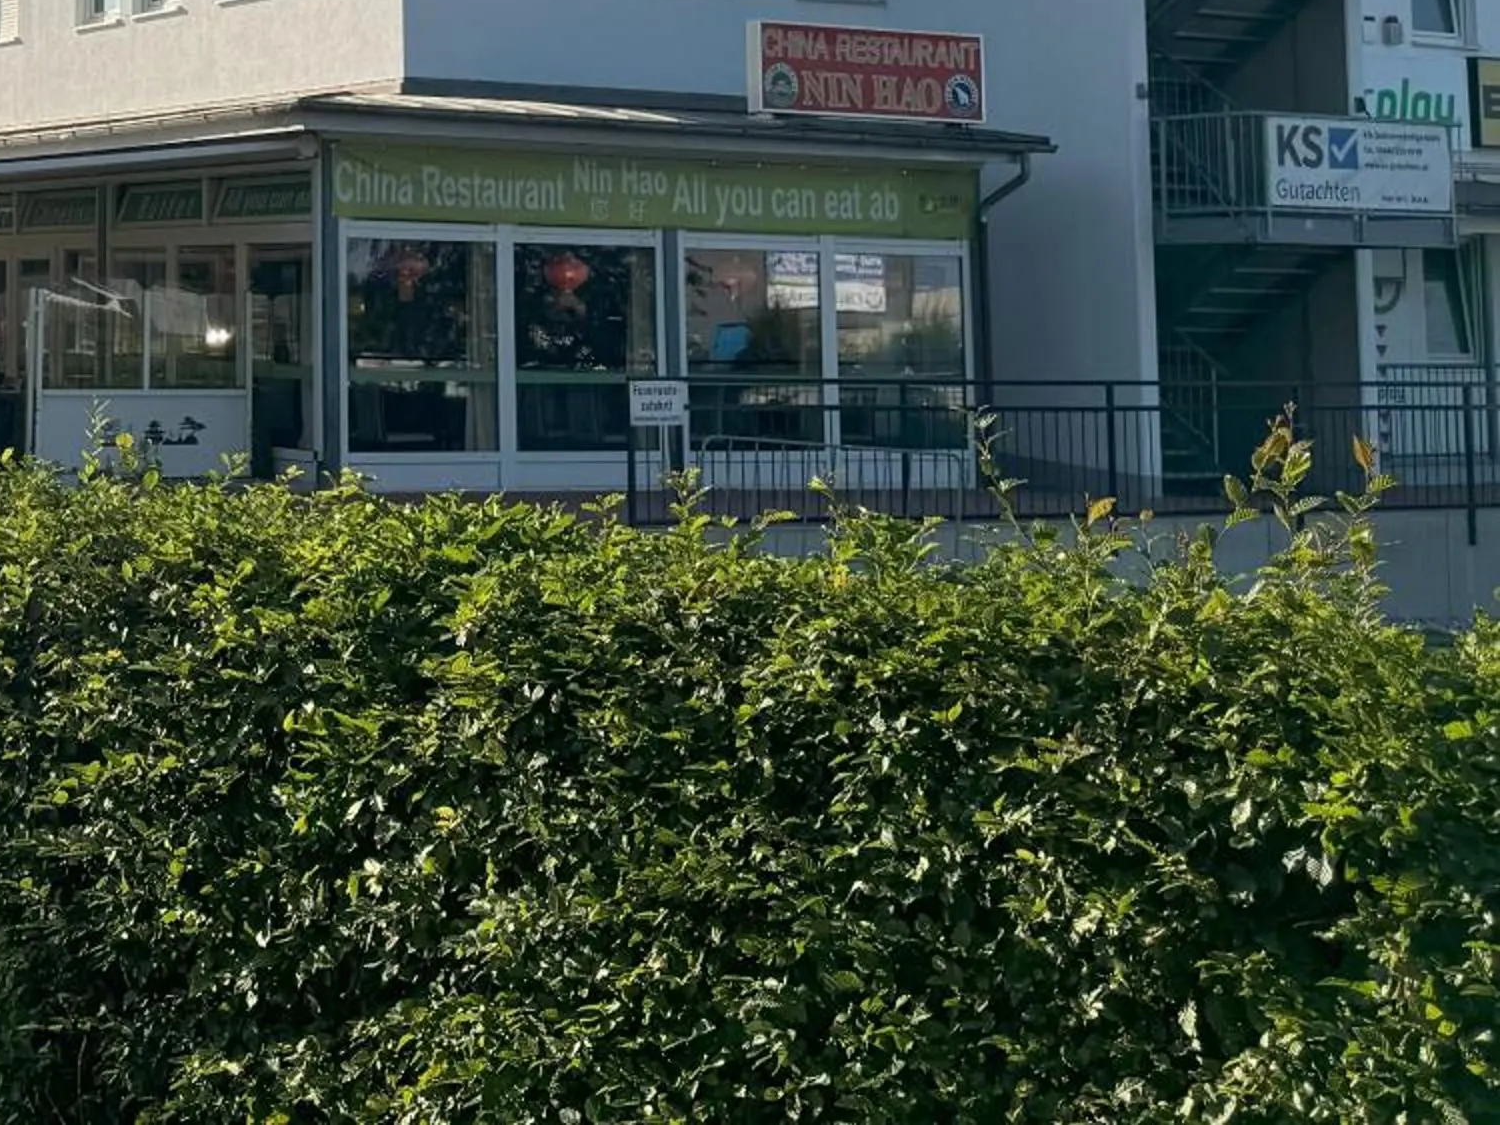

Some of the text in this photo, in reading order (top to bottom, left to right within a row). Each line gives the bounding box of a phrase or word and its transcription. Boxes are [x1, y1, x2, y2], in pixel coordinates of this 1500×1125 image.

[763, 28, 979, 71] CHINA RESTAURANT
[801, 70, 863, 109] NIN
[872, 74, 943, 114] HAO
[1275, 125, 1325, 169] KS
[335, 161, 414, 205] China
[422, 164, 566, 212] Restaurant
[573, 155, 668, 196] Nin Hao
[1276, 178, 1361, 203] Gutachten
[672, 173, 708, 216] All
[715, 185, 763, 226] you
[770, 186, 816, 218] can
[824, 182, 863, 220] eat
[869, 185, 900, 221] ab
